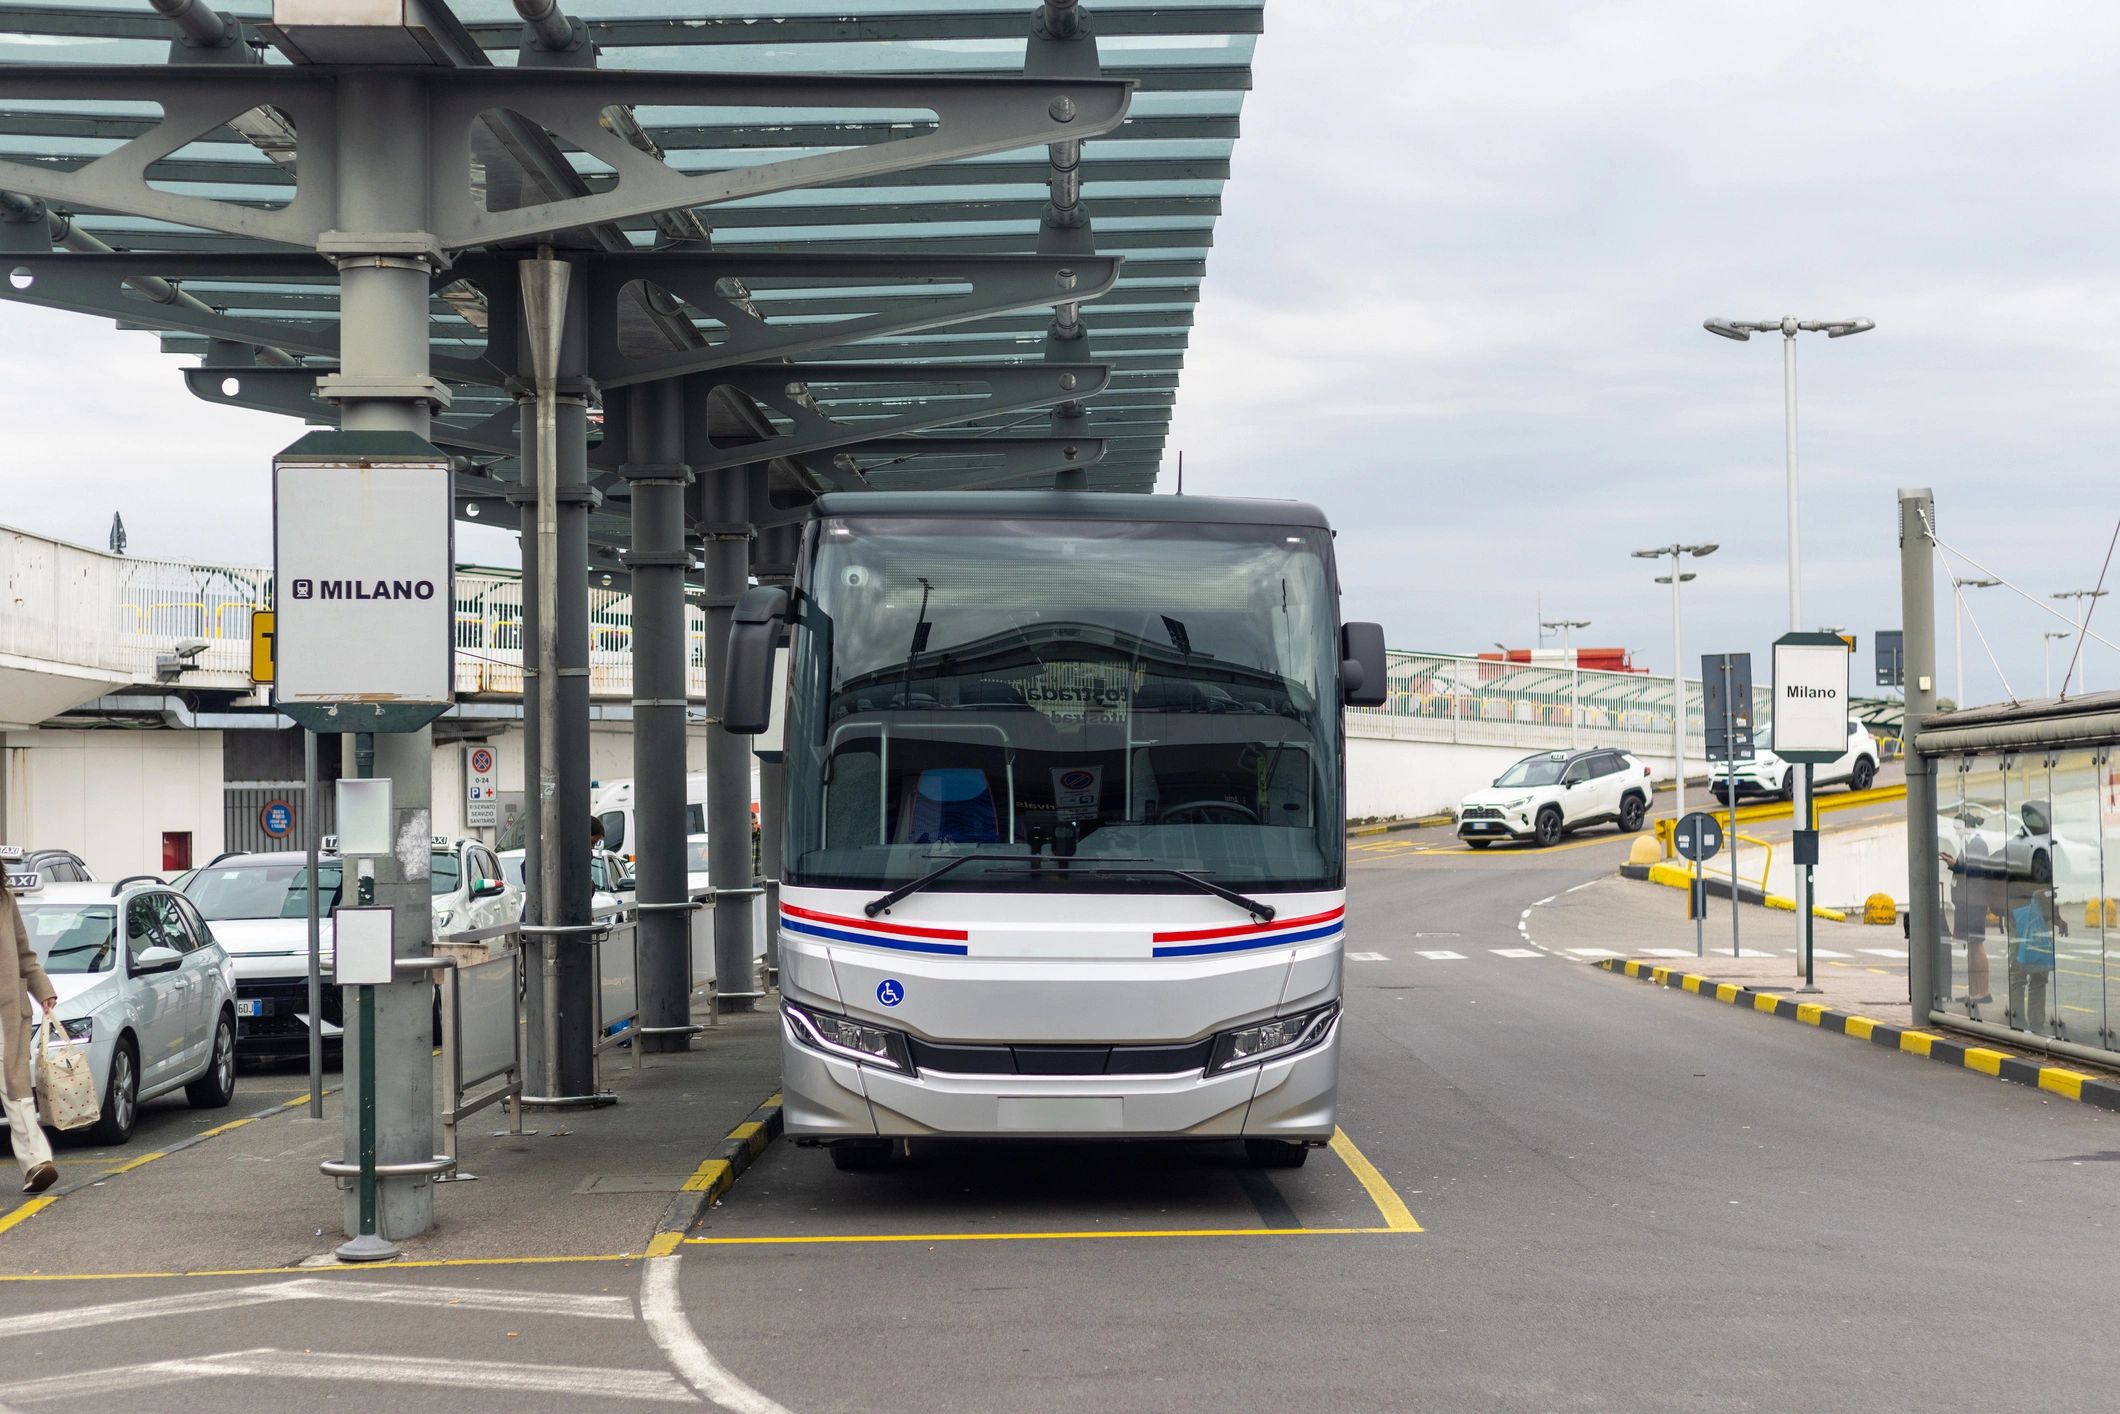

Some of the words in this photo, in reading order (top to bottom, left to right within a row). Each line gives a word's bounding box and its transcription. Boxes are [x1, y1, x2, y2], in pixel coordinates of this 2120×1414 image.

[320, 580, 434, 600] MILANO
[1787, 685, 1836, 699] Milano
[5, 876, 35, 886] AXI
